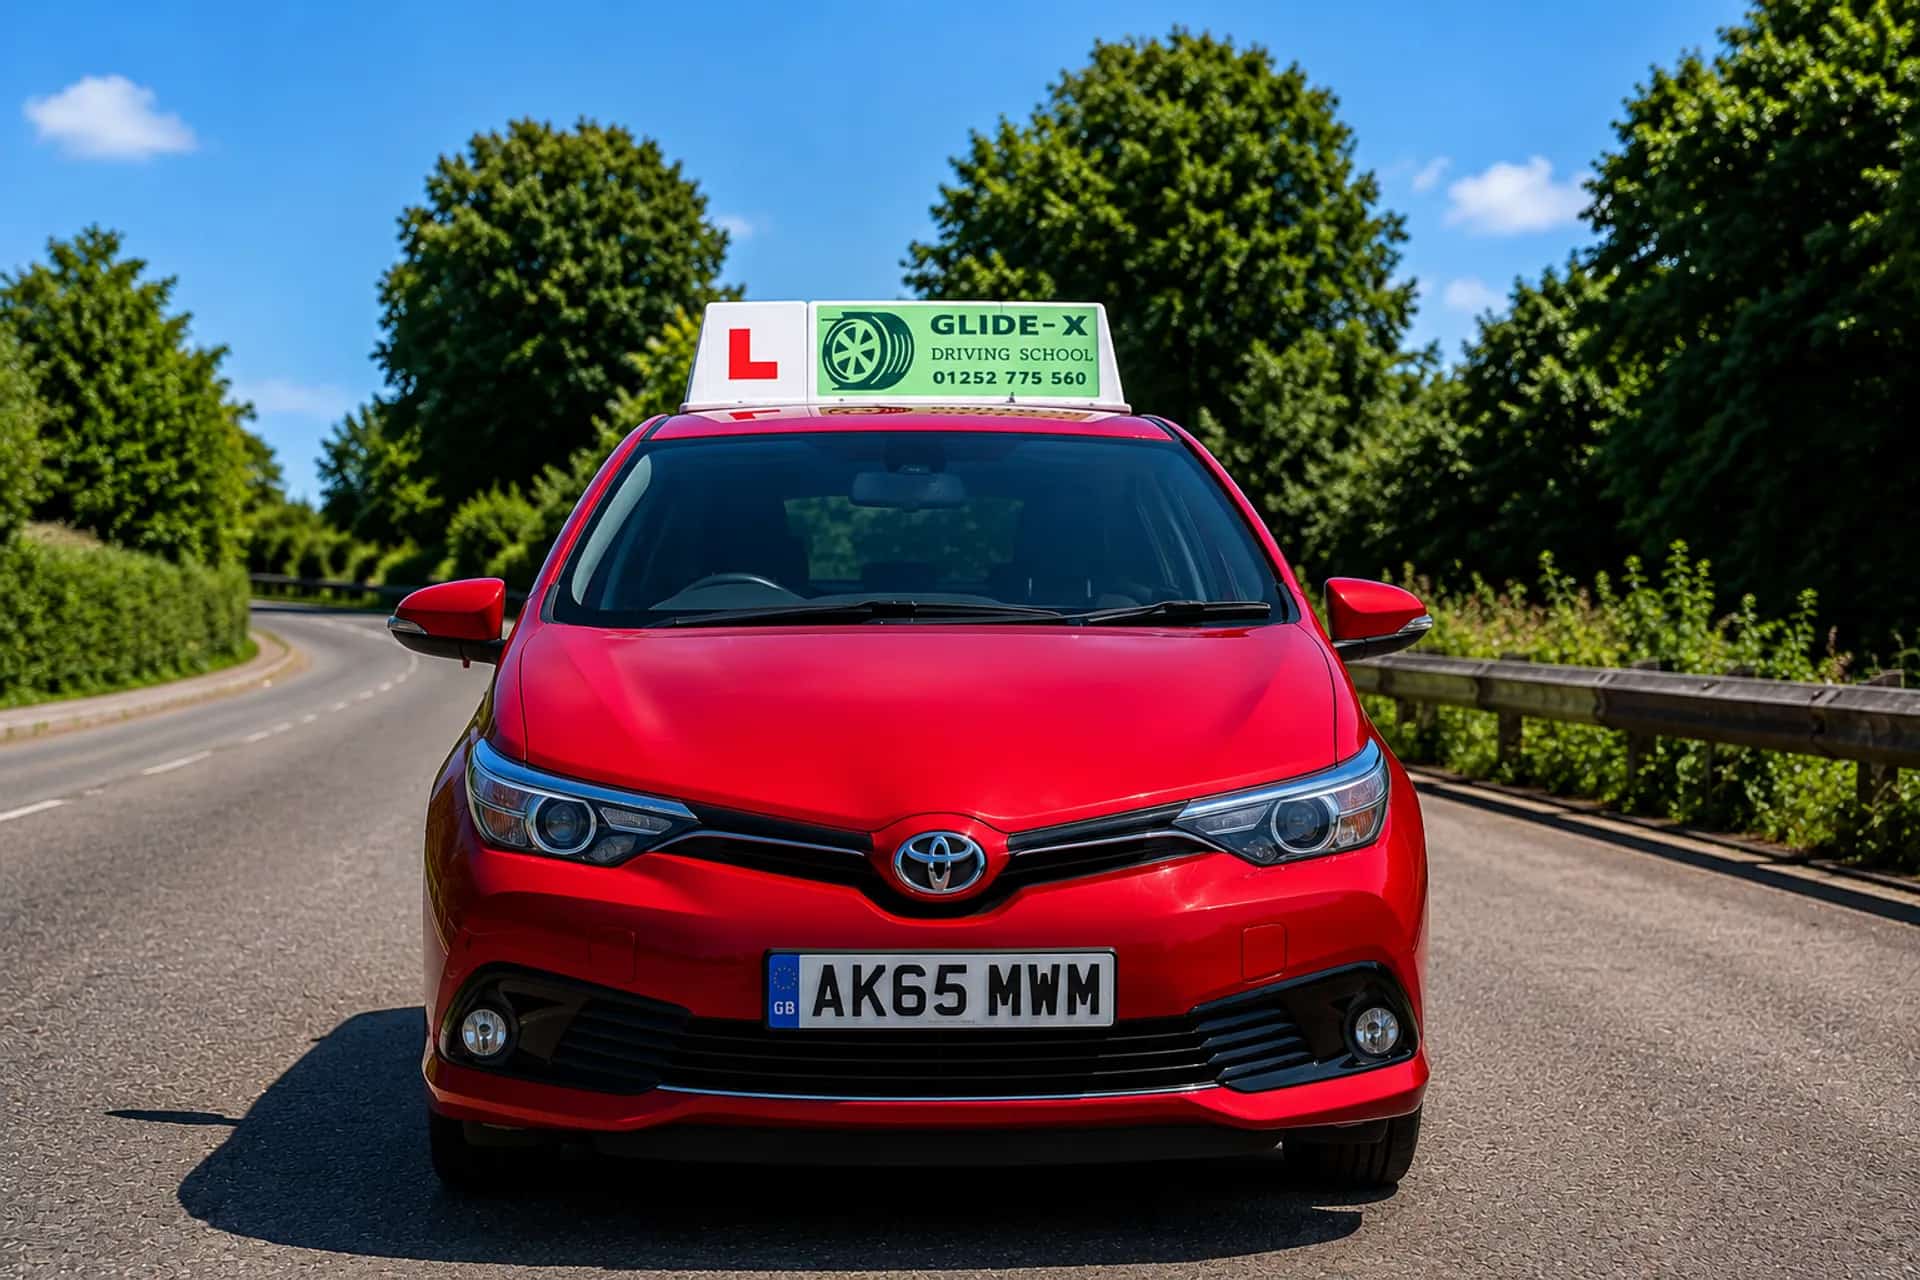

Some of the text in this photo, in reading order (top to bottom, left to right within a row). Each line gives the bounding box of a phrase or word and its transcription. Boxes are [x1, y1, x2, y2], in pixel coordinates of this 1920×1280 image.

[930, 314, 1089, 336] GLIDE-X
[729, 328, 778, 380] L
[931, 347, 1094, 362] DRIVING SCHOOL
[932, 370, 1087, 386] 01252 775 560
[811, 963, 1100, 1017] AK65 MWM
[774, 1001, 795, 1015] GB
